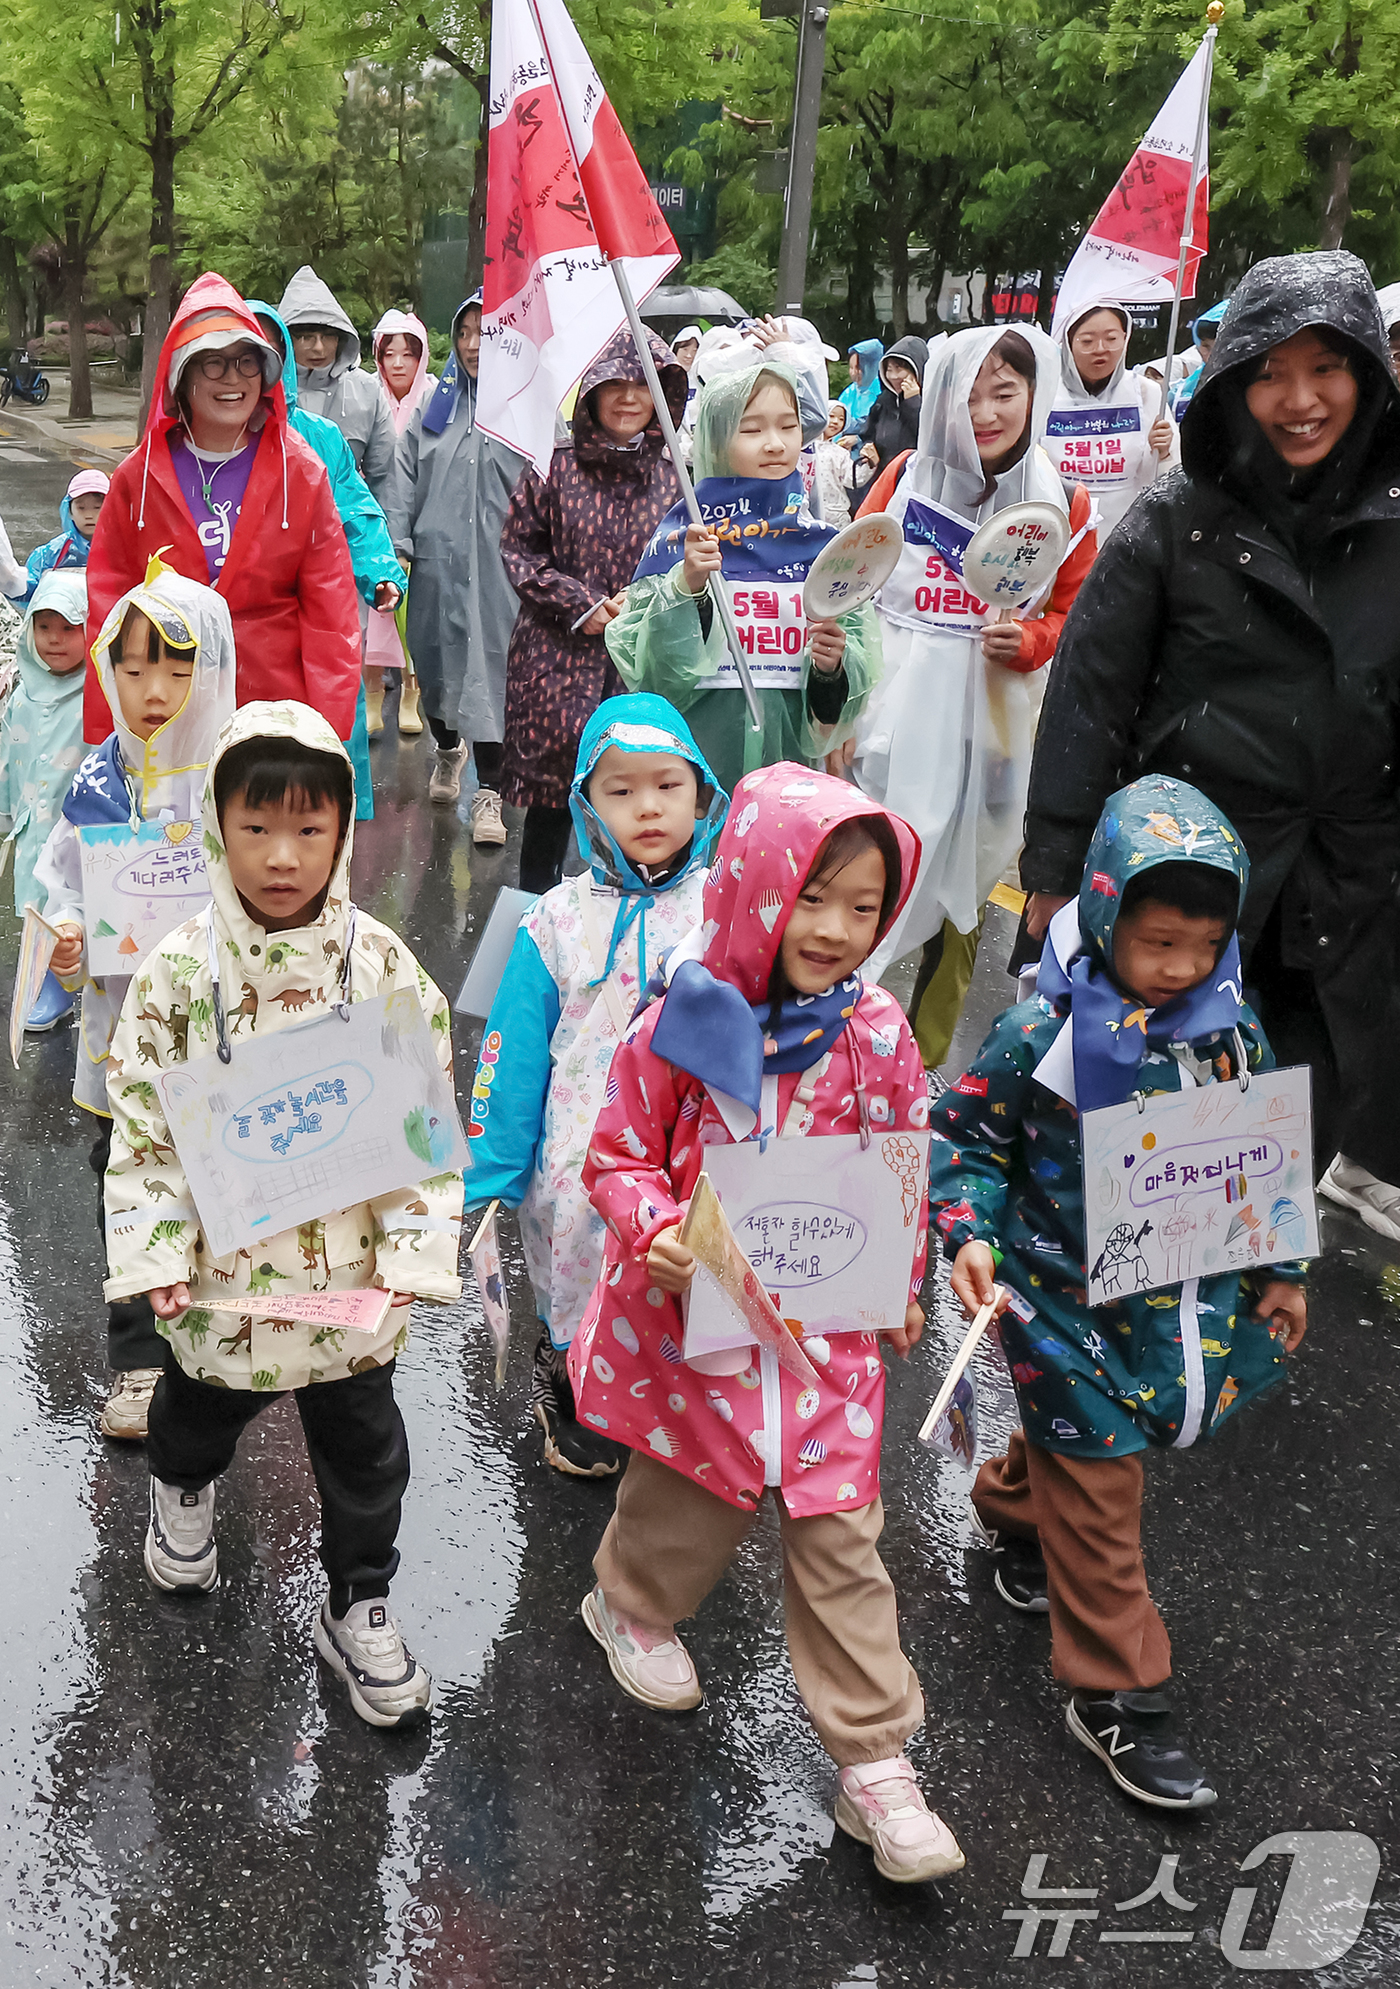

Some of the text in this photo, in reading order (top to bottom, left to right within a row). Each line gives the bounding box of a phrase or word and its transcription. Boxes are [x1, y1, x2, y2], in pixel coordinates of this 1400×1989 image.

[1064, 438, 1122, 457] 5월 1일
[1060, 457, 1126, 475] 어린이날
[701, 498, 752, 521] 2024
[733, 591, 779, 619] 5월
[151, 847, 202, 866] 느려도
